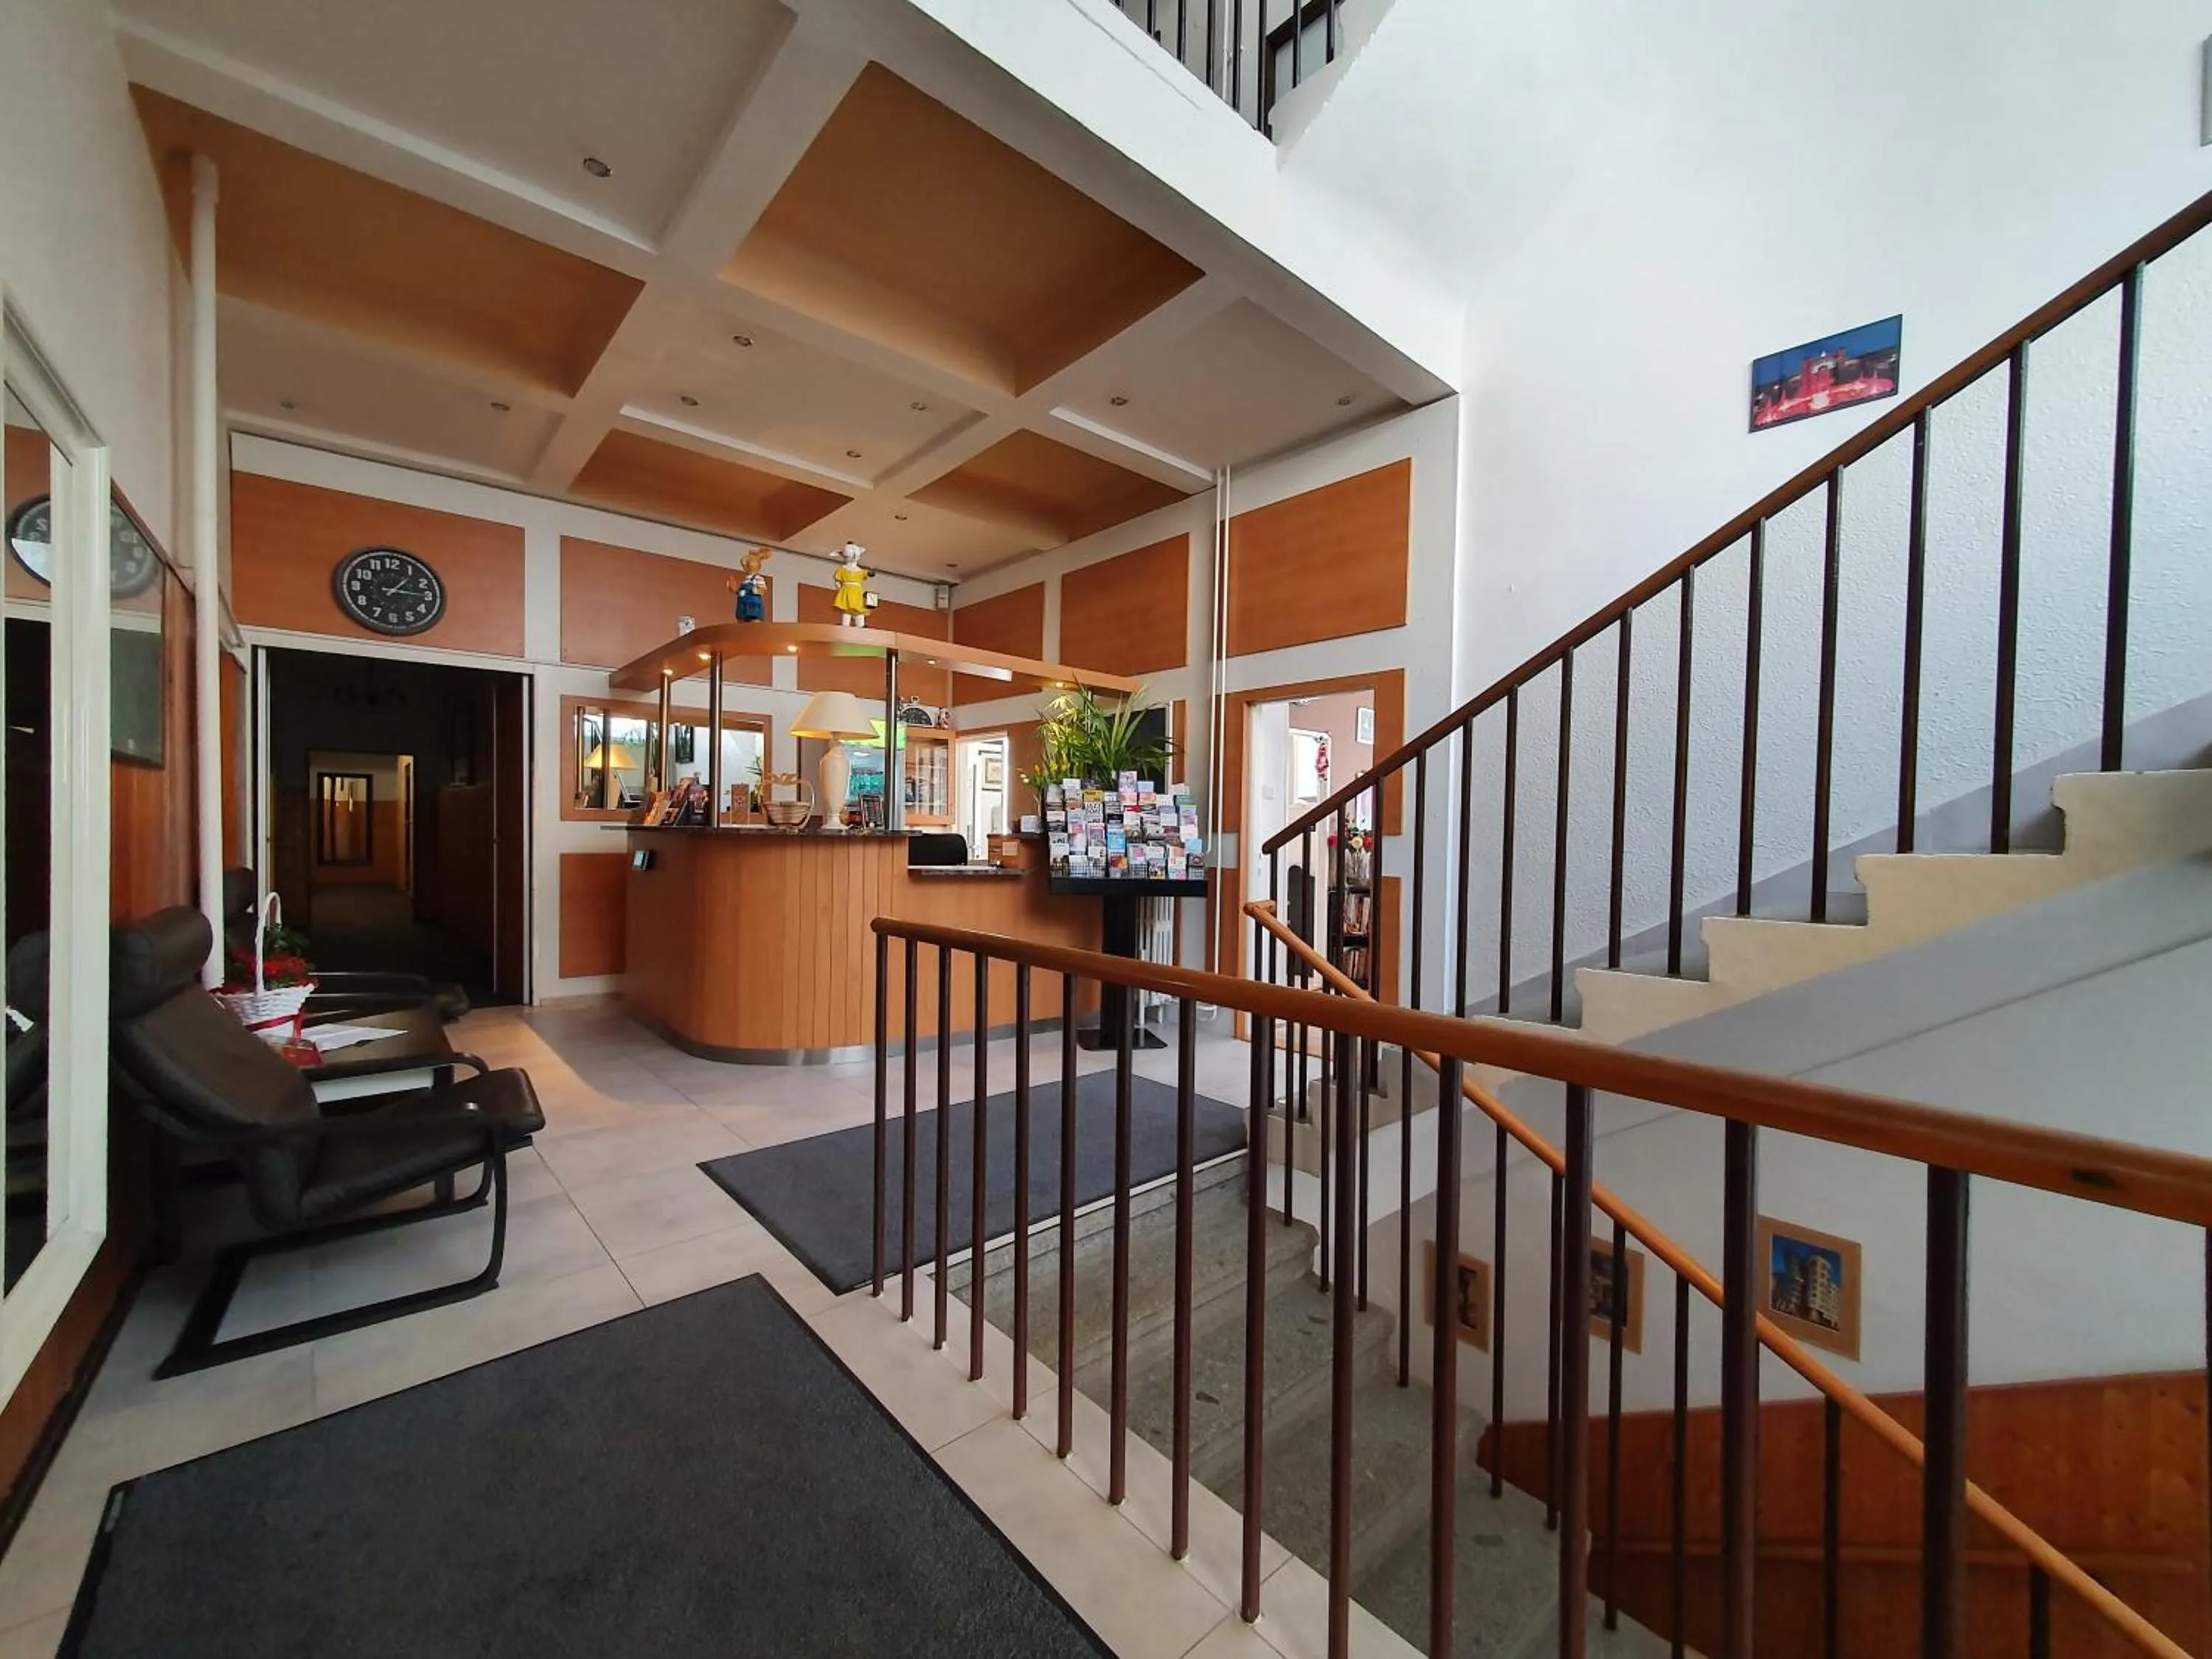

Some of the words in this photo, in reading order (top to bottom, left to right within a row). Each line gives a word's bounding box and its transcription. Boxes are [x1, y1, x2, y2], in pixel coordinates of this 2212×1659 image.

[369, 559, 381, 571] 11
[384, 558, 400, 570] 12
[355, 568, 372, 580] 10
[406, 565, 413, 576] 1
[351, 580, 361, 591] 9
[419, 579, 428, 589] 2
[358, 595, 366, 605] 8
[424, 591, 433, 601] 3
[372, 607, 382, 617] 7
[417, 603, 426, 613] 4
[389, 613, 398, 623] 6
[405, 611, 414, 622] 5
